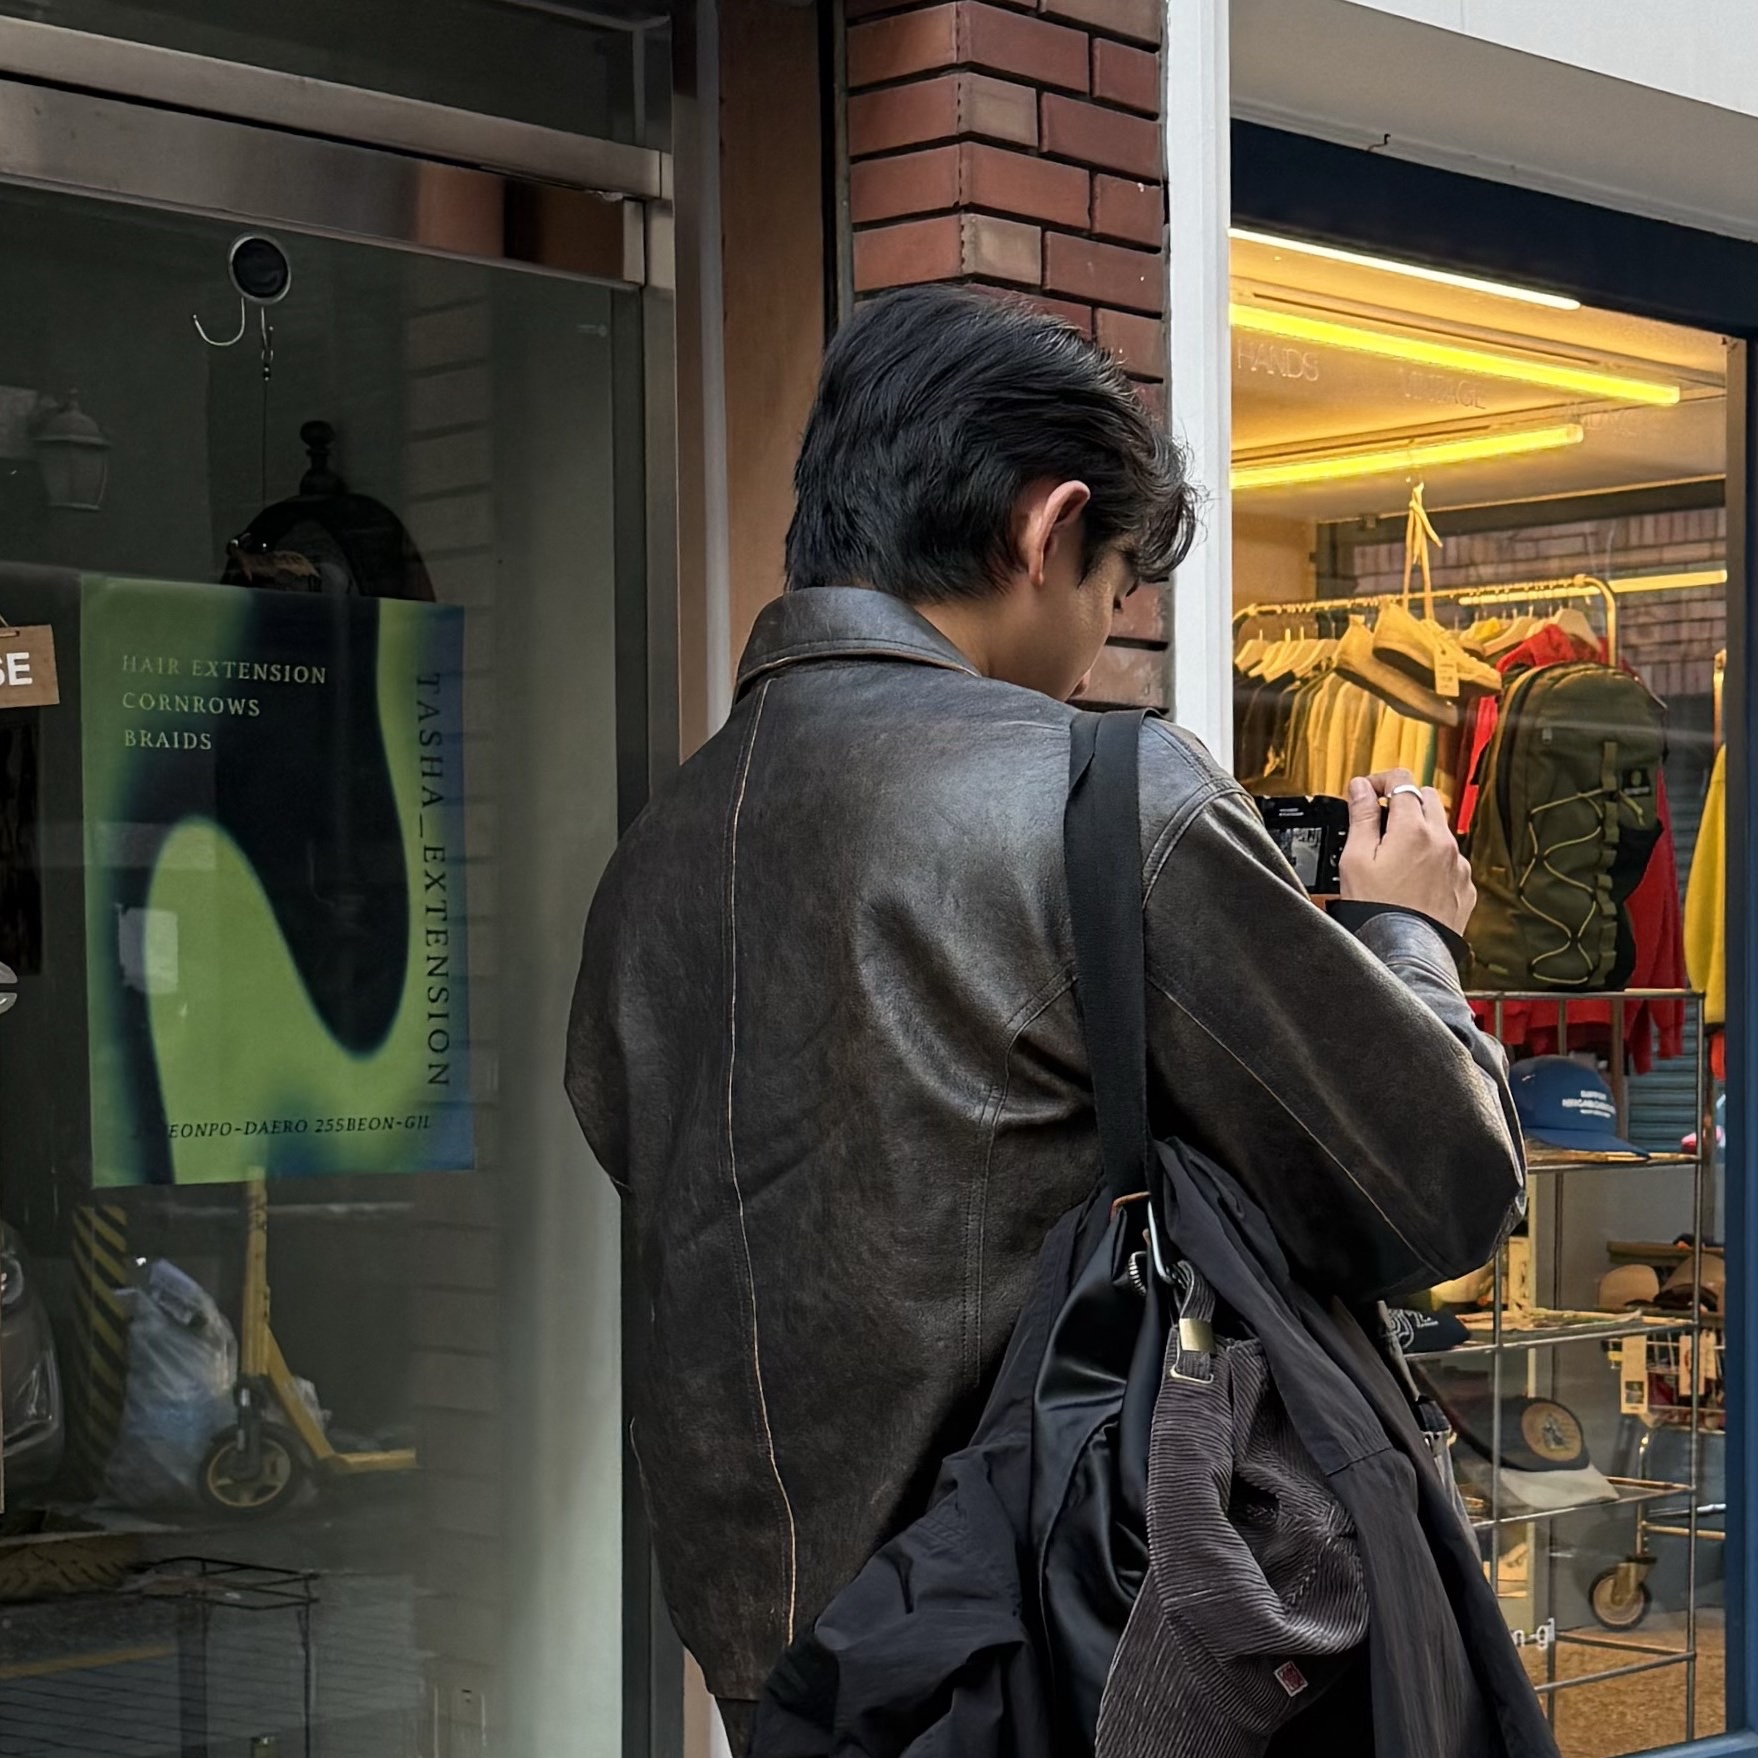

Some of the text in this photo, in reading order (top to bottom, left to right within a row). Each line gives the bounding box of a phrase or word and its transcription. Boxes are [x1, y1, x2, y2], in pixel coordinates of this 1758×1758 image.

[122, 655, 326, 684] HAIR EXTENSION
[122, 692, 261, 717] CORNROWS
[124, 729, 212, 750] BRAIDS
[168, 1119, 308, 1139] EONPO-DAERO
